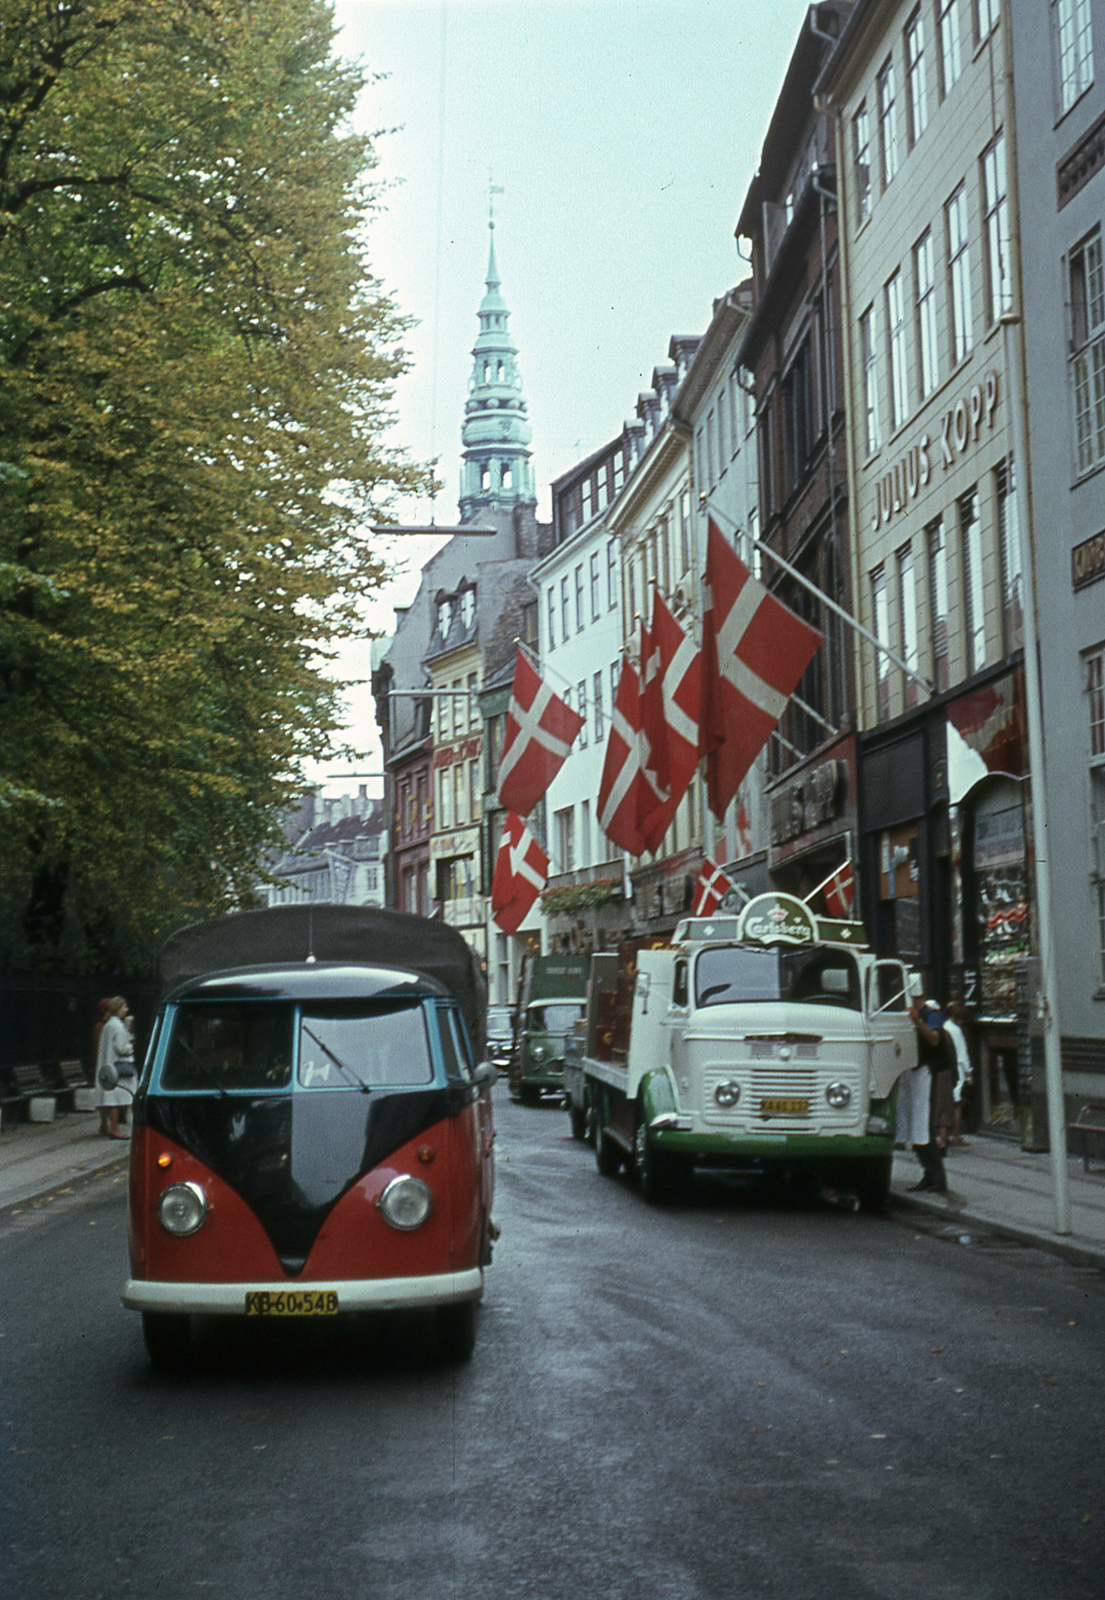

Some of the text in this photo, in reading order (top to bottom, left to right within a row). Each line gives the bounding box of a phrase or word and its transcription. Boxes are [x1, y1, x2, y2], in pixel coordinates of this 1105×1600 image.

[871, 369, 998, 532] JULIUS KOPP
[745, 916, 811, 944] Carlsberg
